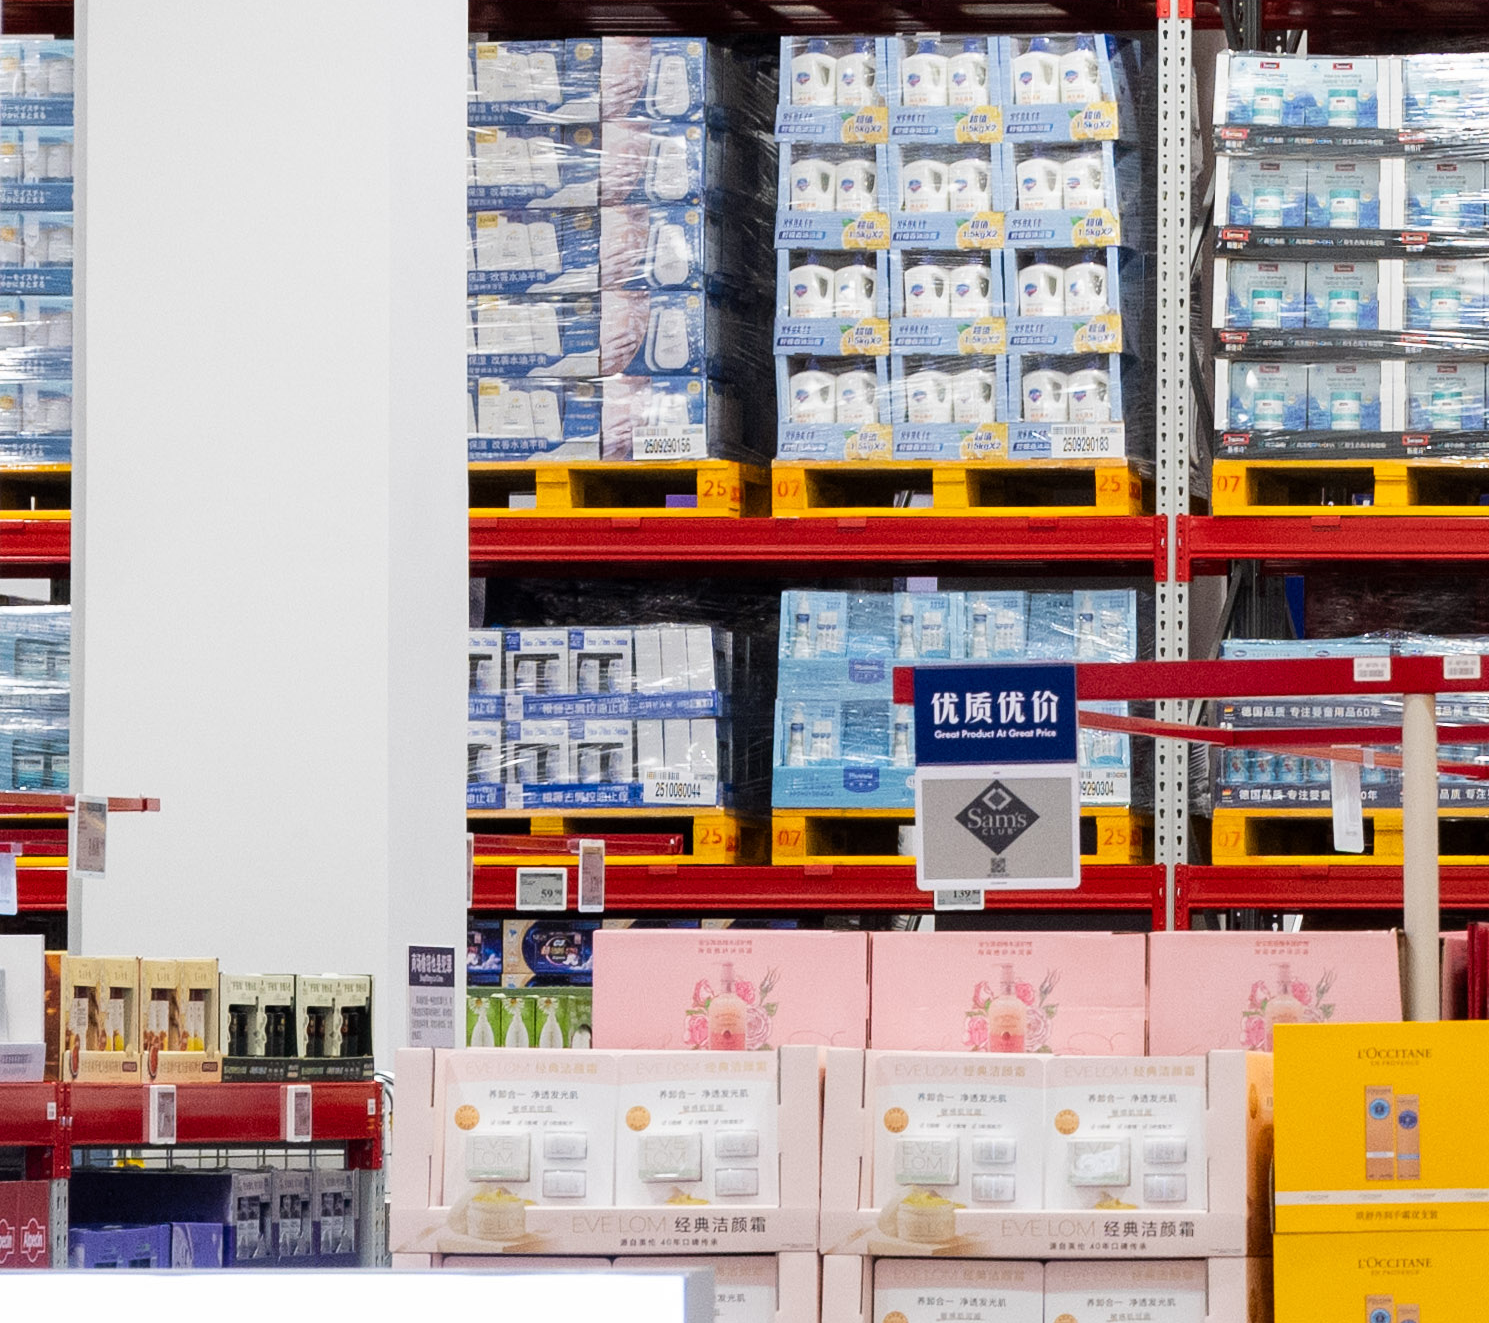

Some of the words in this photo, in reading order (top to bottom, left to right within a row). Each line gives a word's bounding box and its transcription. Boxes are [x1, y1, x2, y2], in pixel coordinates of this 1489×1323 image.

[1084, 111, 1102, 123] 超值
[1062, 435, 1109, 453] 2509290183
[703, 480, 727, 499] 25
[931, 691, 1059, 724] 优质优价
[1241, 707, 1285, 718] 德国品质
[1290, 706, 1381, 717] 专注婴童用品60年
[935, 730, 959, 739] Great
[962, 730, 994, 738] Product
[1009, 729, 1034, 737] Great
[1036, 729, 1056, 737] Price
[655, 782, 701, 798] 2510080044
[968, 808, 1027, 828] Sam's
[1356, 1046, 1432, 1060] L'OCCITANE
[1088, 1094, 1125, 1103] 养卸合一
[1130, 1094, 1177, 1103] 净透发光肌
[674, 1216, 766, 1234] 经典洁颜霜
